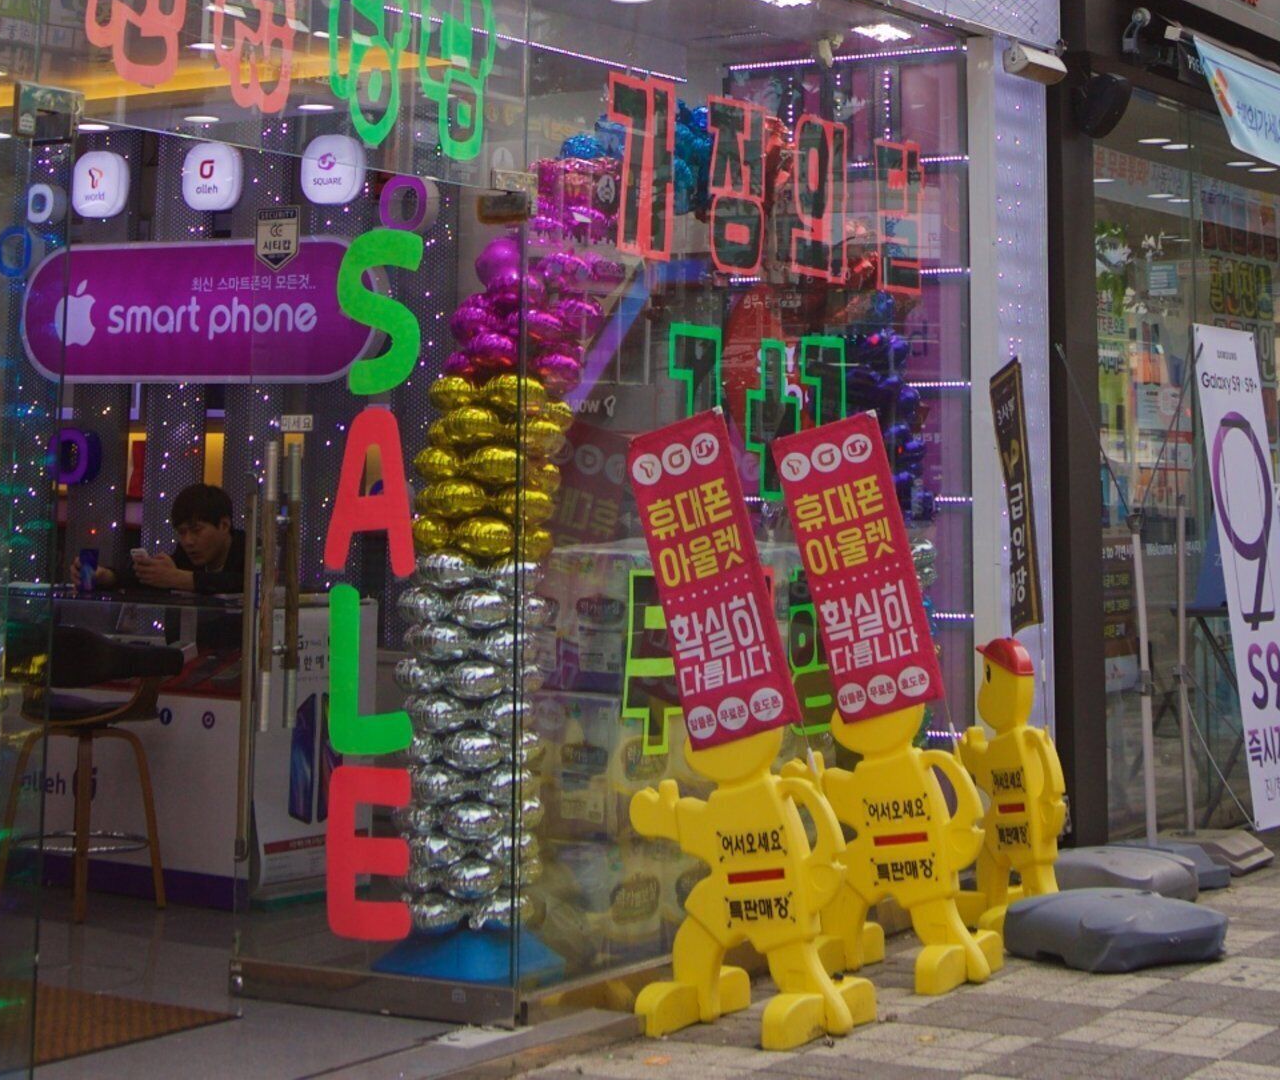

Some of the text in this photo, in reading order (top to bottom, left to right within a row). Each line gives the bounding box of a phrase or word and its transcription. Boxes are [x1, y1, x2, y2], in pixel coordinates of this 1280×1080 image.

[195, 183, 218, 195] olleh
[262, 238, 292, 252] 시티캅
[191, 276, 214, 293] 최신
[216, 275, 272, 293] 스마트폰의
[107, 296, 318, 341] smart phone
[1200, 371, 1232, 395] Galaxy
[646, 477, 734, 542] 휴대폰
[793, 473, 885, 533] 휴대폰
[658, 524, 745, 588] 아울렛
[804, 517, 896, 576] 아울렛
[322, 228, 428, 943] SALE
[820, 579, 914, 642] 확실히
[670, 591, 766, 662] 확실히
[867, 680, 896, 697] 무료폰
[897, 673, 929, 690] 효도폰
[718, 705, 748, 725] 무료폰
[751, 695, 782, 716] 효도폰
[992, 768, 1027, 793] 어서오세요
[867, 796, 928, 822] 어서오세요
[721, 826, 783, 855] 어서오세요
[997, 824, 1029, 850] 특판매장
[874, 857, 936, 884] 특판매장
[727, 895, 791, 922] 특판매장
